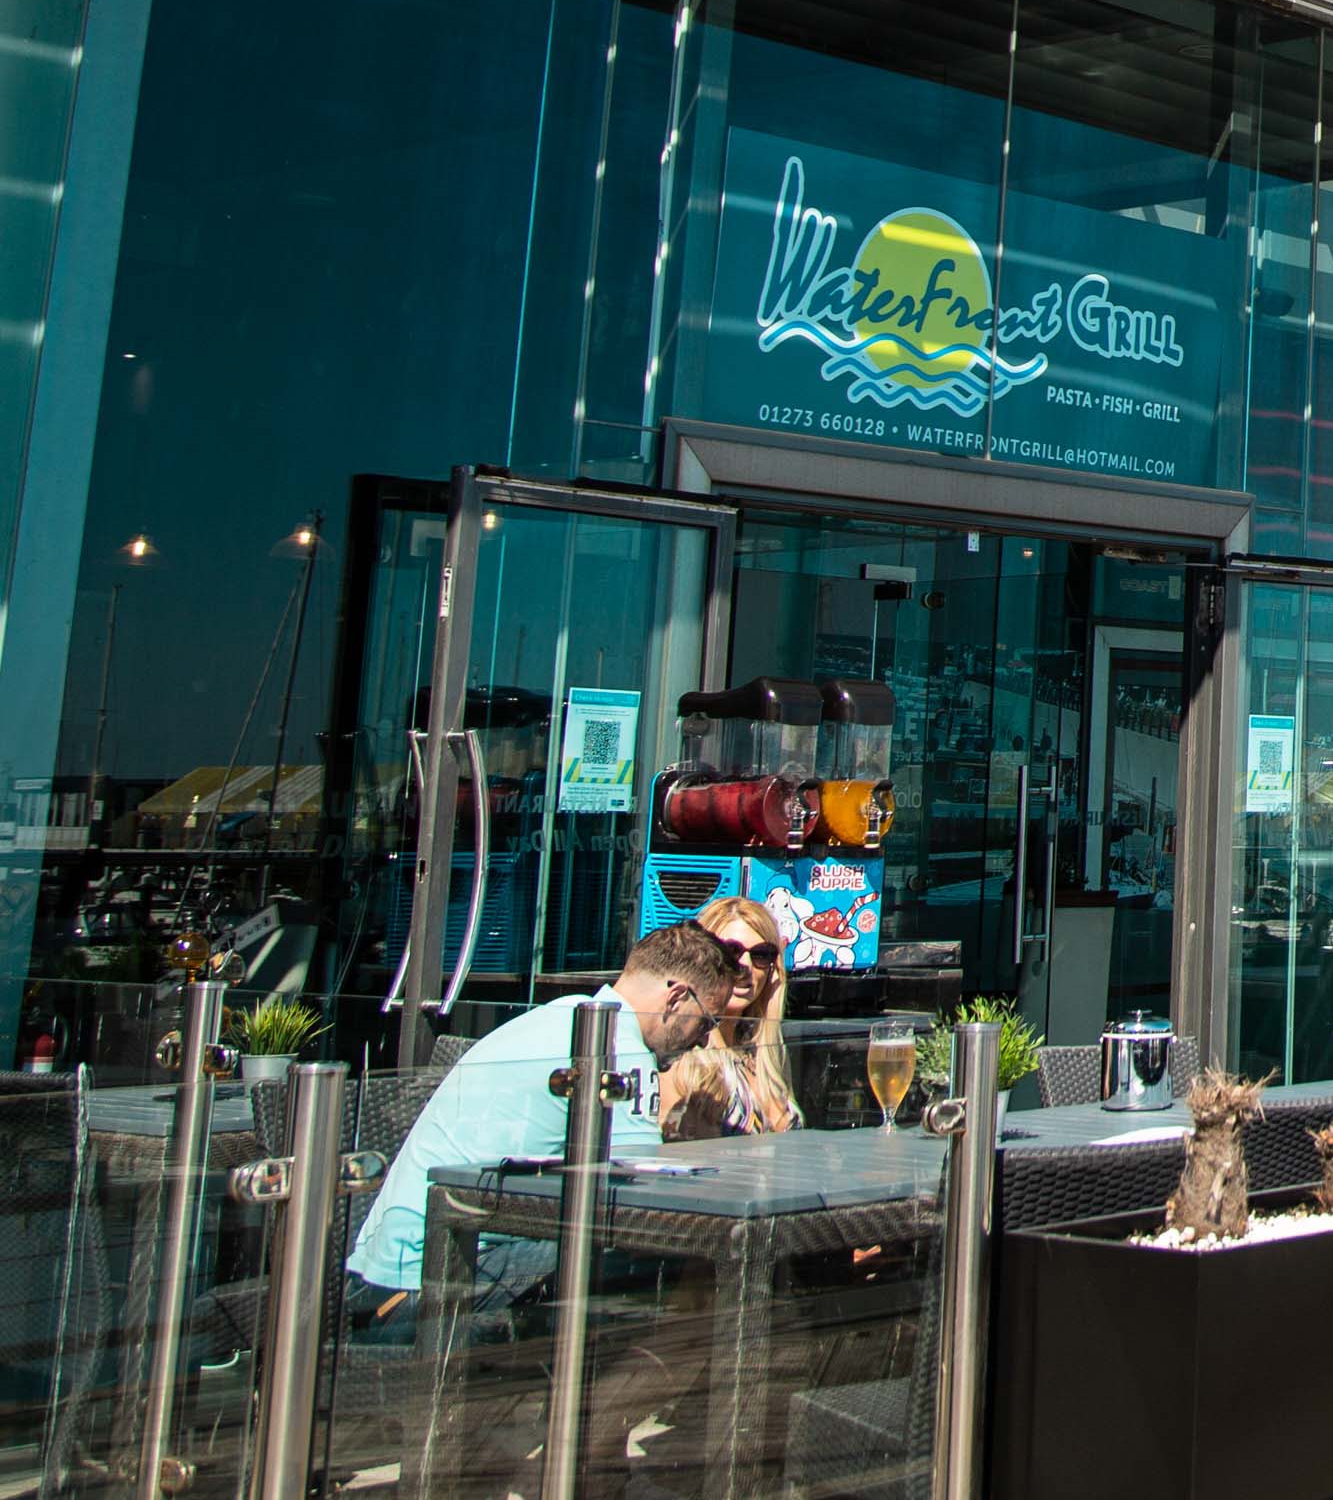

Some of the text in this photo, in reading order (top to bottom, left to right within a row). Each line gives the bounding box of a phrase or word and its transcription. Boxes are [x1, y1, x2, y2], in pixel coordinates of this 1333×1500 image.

[1046, 385, 1182, 423] PASTA FISH GRILL
[758, 404, 1176, 478] 01273 660128 WATERFRONTGRILL@HOTMAIL.COM
[810, 864, 866, 879] SLUSH
